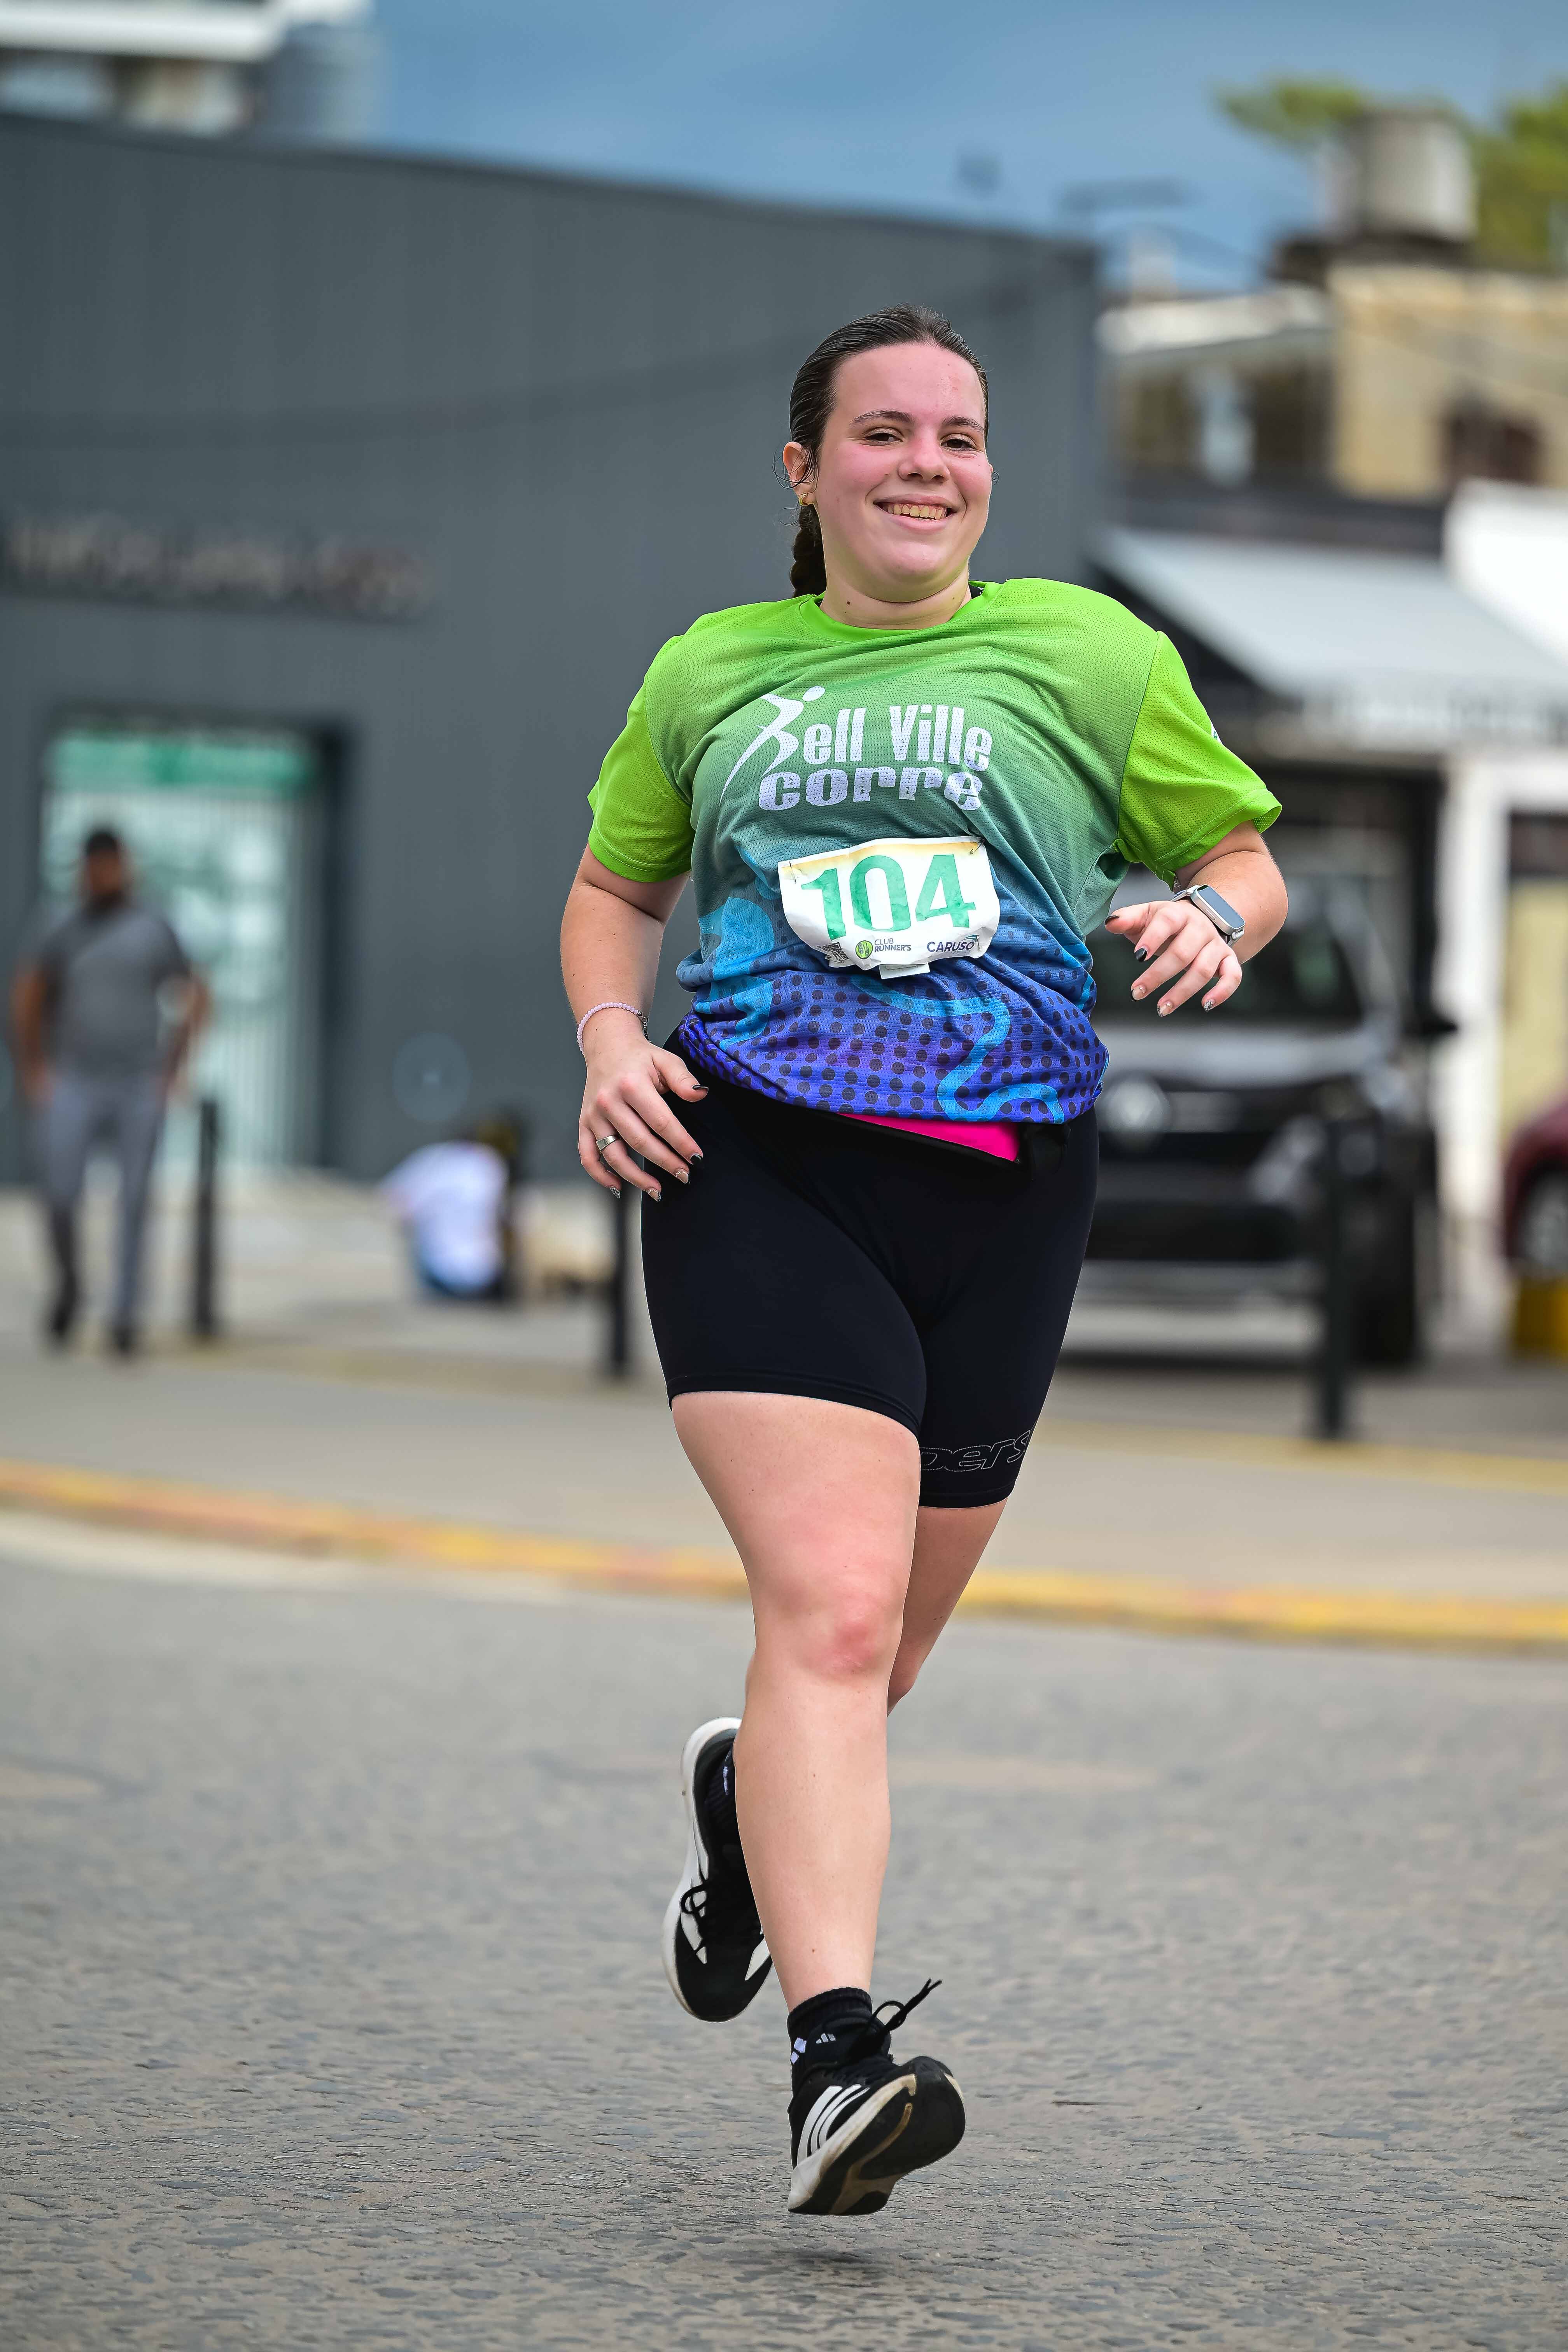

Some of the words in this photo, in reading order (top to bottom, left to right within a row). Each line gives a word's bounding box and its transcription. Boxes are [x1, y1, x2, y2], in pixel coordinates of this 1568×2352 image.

[889, 704, 993, 772] Ville
[758, 766, 984, 811] corre
[802, 854, 976, 940] 104
[874, 945, 911, 953] RUNNER'S
[927, 941, 975, 952] CARUSO
